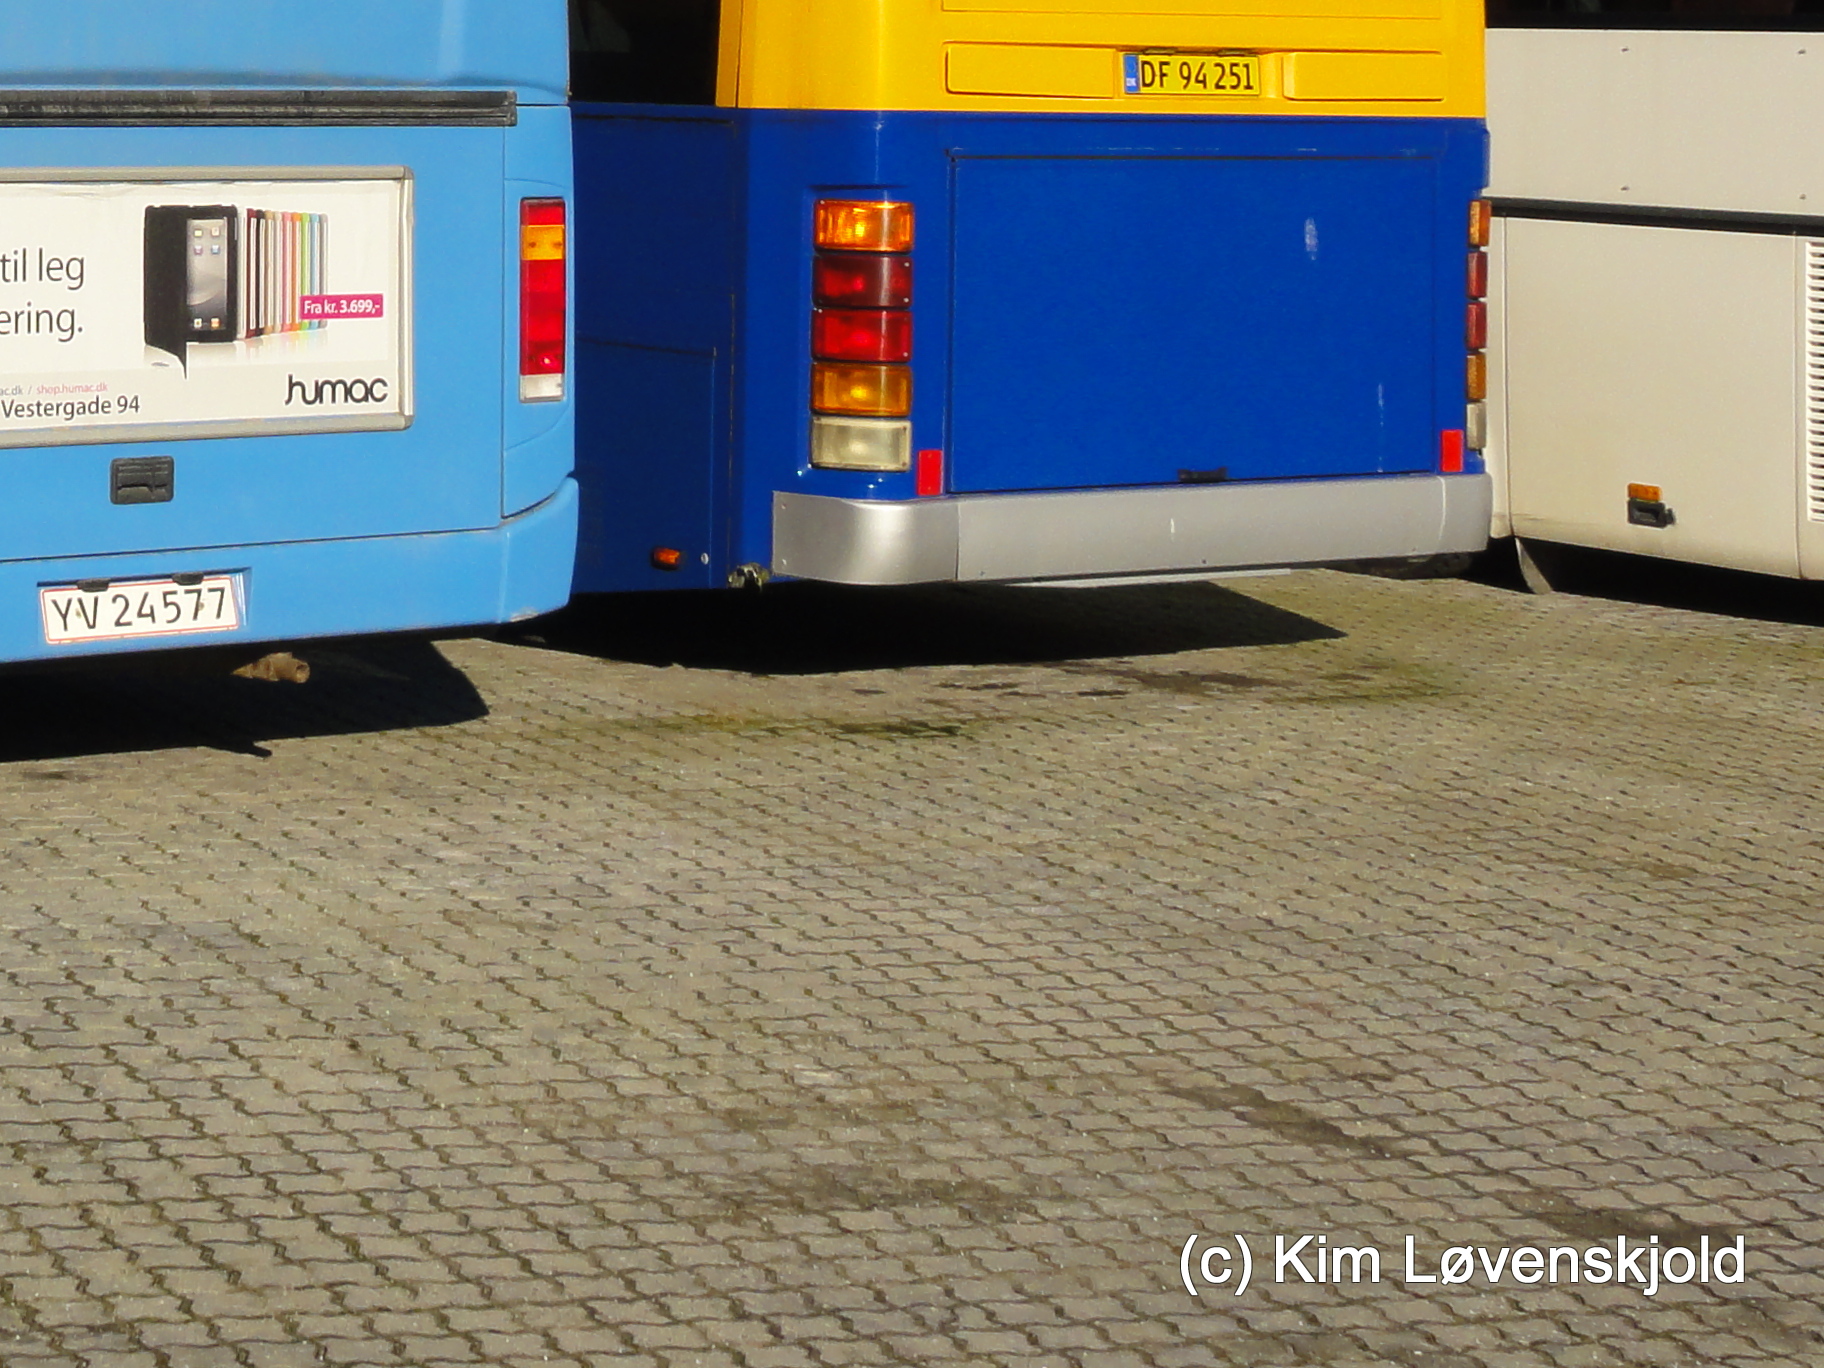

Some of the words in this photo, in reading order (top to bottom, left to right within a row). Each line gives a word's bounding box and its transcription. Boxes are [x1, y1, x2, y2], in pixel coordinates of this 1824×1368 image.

[1141, 60, 1170, 88] DF
[1179, 61, 1207, 89] 94
[1214, 62, 1254, 90] 251
[0, 249, 29, 283] til
[38, 246, 86, 290] leg
[303, 299, 322, 315] Fra
[323, 298, 338, 314] kr.
[339, 299, 380, 314] 3.699,-
[36, 382, 108, 396] shop.humac.dk
[284, 374, 388, 407] humac
[2, 395, 112, 421] Vestergade
[117, 395, 140, 413] 94
[52, 595, 100, 632] YV
[111, 587, 226, 628] 24577
